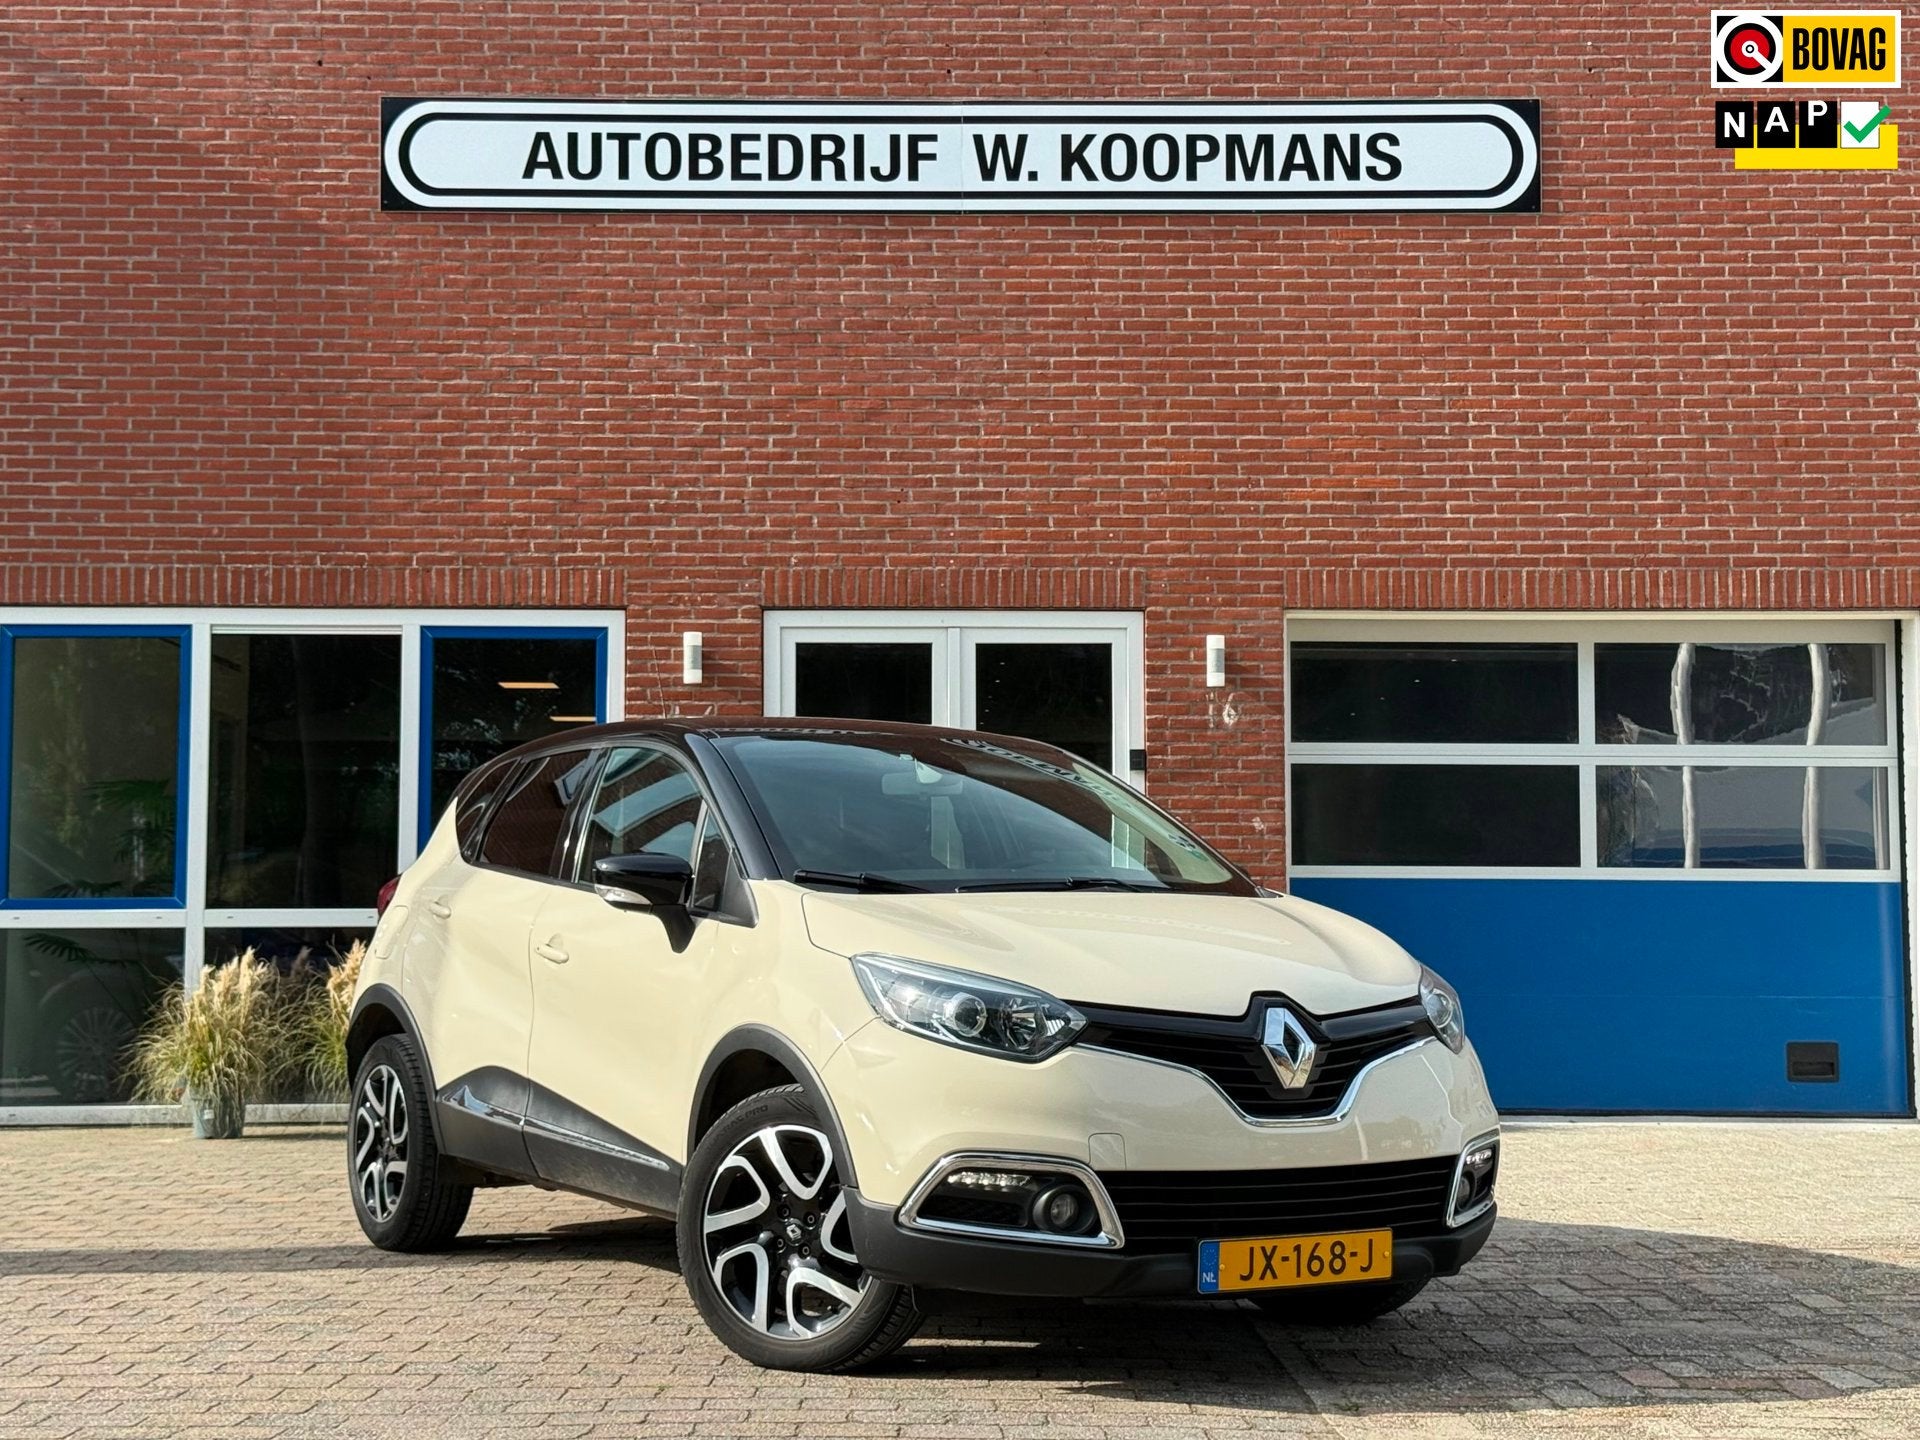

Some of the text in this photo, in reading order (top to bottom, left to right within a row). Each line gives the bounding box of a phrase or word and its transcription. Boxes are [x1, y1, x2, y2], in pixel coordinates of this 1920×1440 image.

[521, 131, 1402, 182] AUTOBEDRIJF W. KOOPMANS
[1202, 1271, 1216, 1284] NL
[1239, 1238, 1374, 1282] JX-168-J
